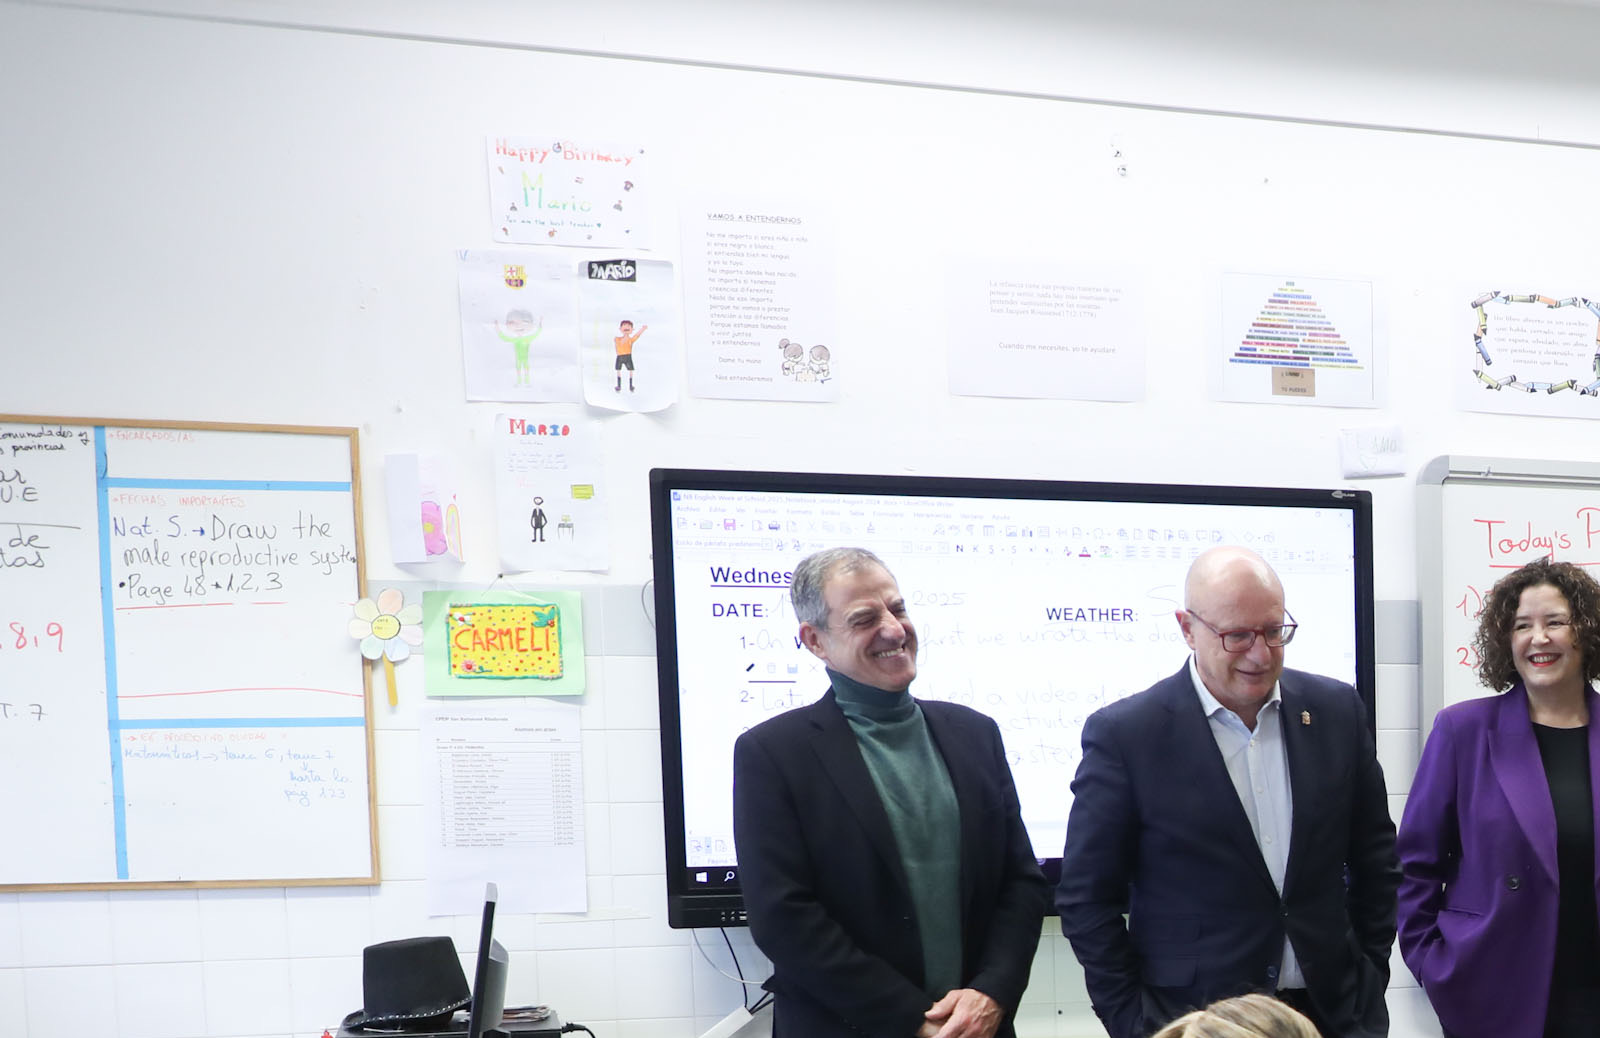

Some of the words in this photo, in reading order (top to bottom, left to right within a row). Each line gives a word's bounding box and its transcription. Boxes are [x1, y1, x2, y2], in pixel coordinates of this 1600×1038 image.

[522, 171, 592, 212] Mario
[508, 418, 570, 436] MARIO
[119, 495, 167, 506] FECHAS
[179, 495, 247, 507] IMPORTANTES
[9, 524, 50, 548] de
[211, 514, 278, 541] Draw
[291, 510, 331, 539] the
[1473, 519, 1571, 563] Today's
[124, 542, 172, 567] male
[180, 543, 299, 577] reproductive
[710, 567, 792, 584] Wednes
[128, 574, 174, 605] Page
[183, 573, 207, 596] 48
[912, 590, 968, 606] 2025
[712, 603, 769, 617] DATE:
[1046, 608, 1139, 622] WEATHER:
[455, 627, 550, 652] CARMELI
